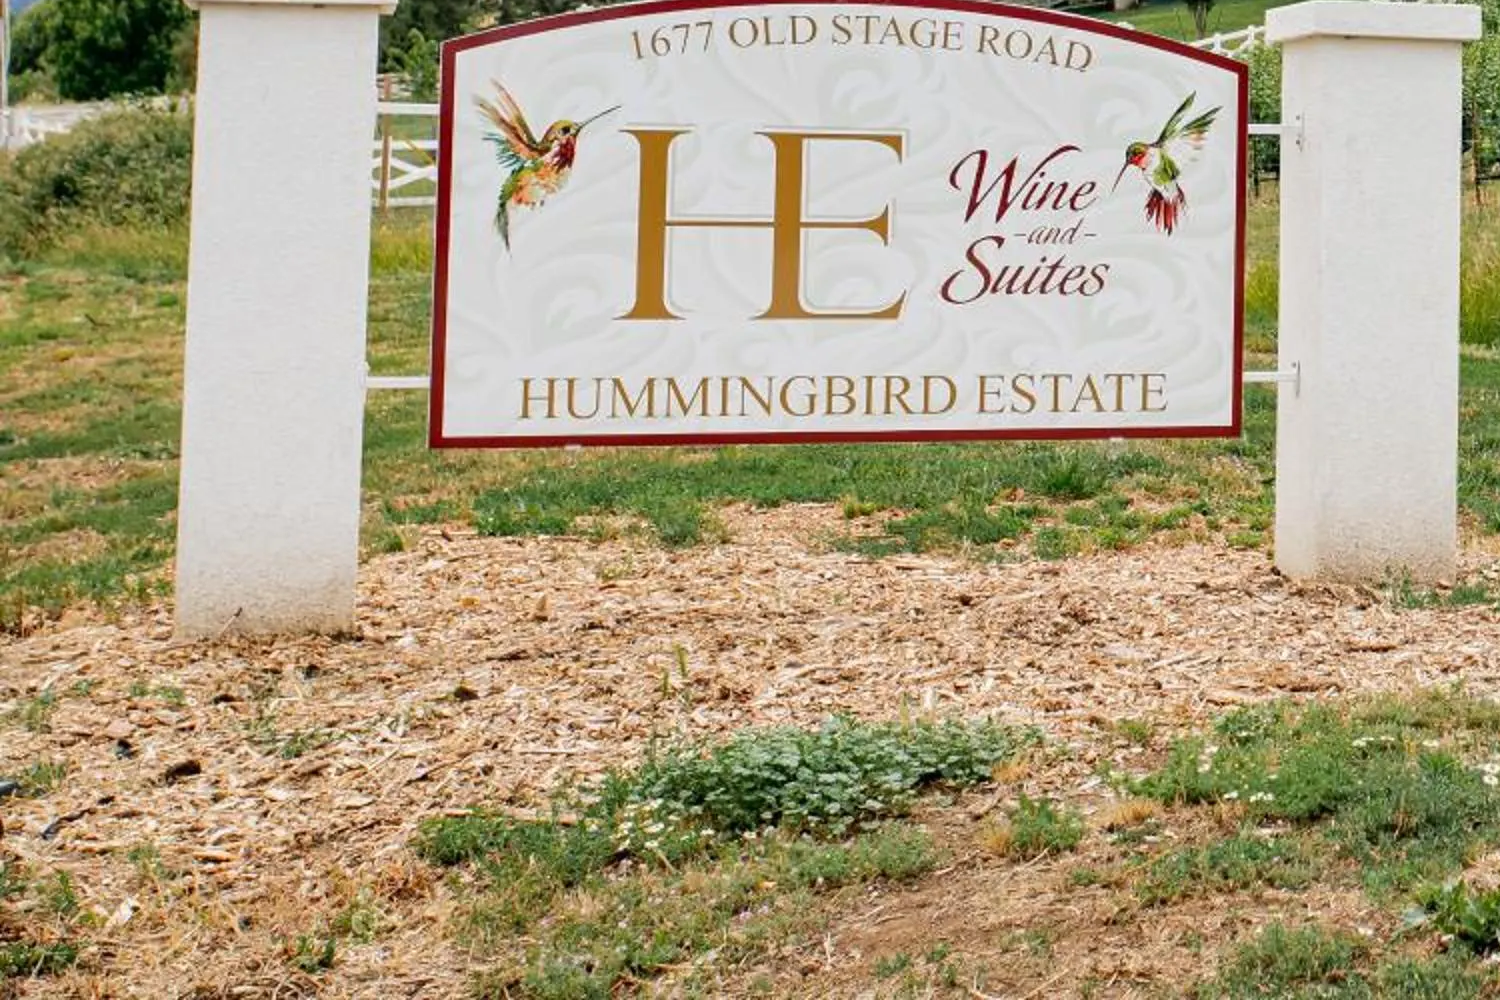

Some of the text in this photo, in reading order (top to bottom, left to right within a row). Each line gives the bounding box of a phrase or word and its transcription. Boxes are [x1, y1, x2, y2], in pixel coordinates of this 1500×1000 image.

[630, 14, 1095, 72] 1677 OLD STAGE ROAD
[948, 145, 1097, 226] Wine
[613, 128, 907, 321] HE
[940, 234, 1111, 305] Suites
[517, 372, 1168, 420] HUMMINGBIRD ESTATE
